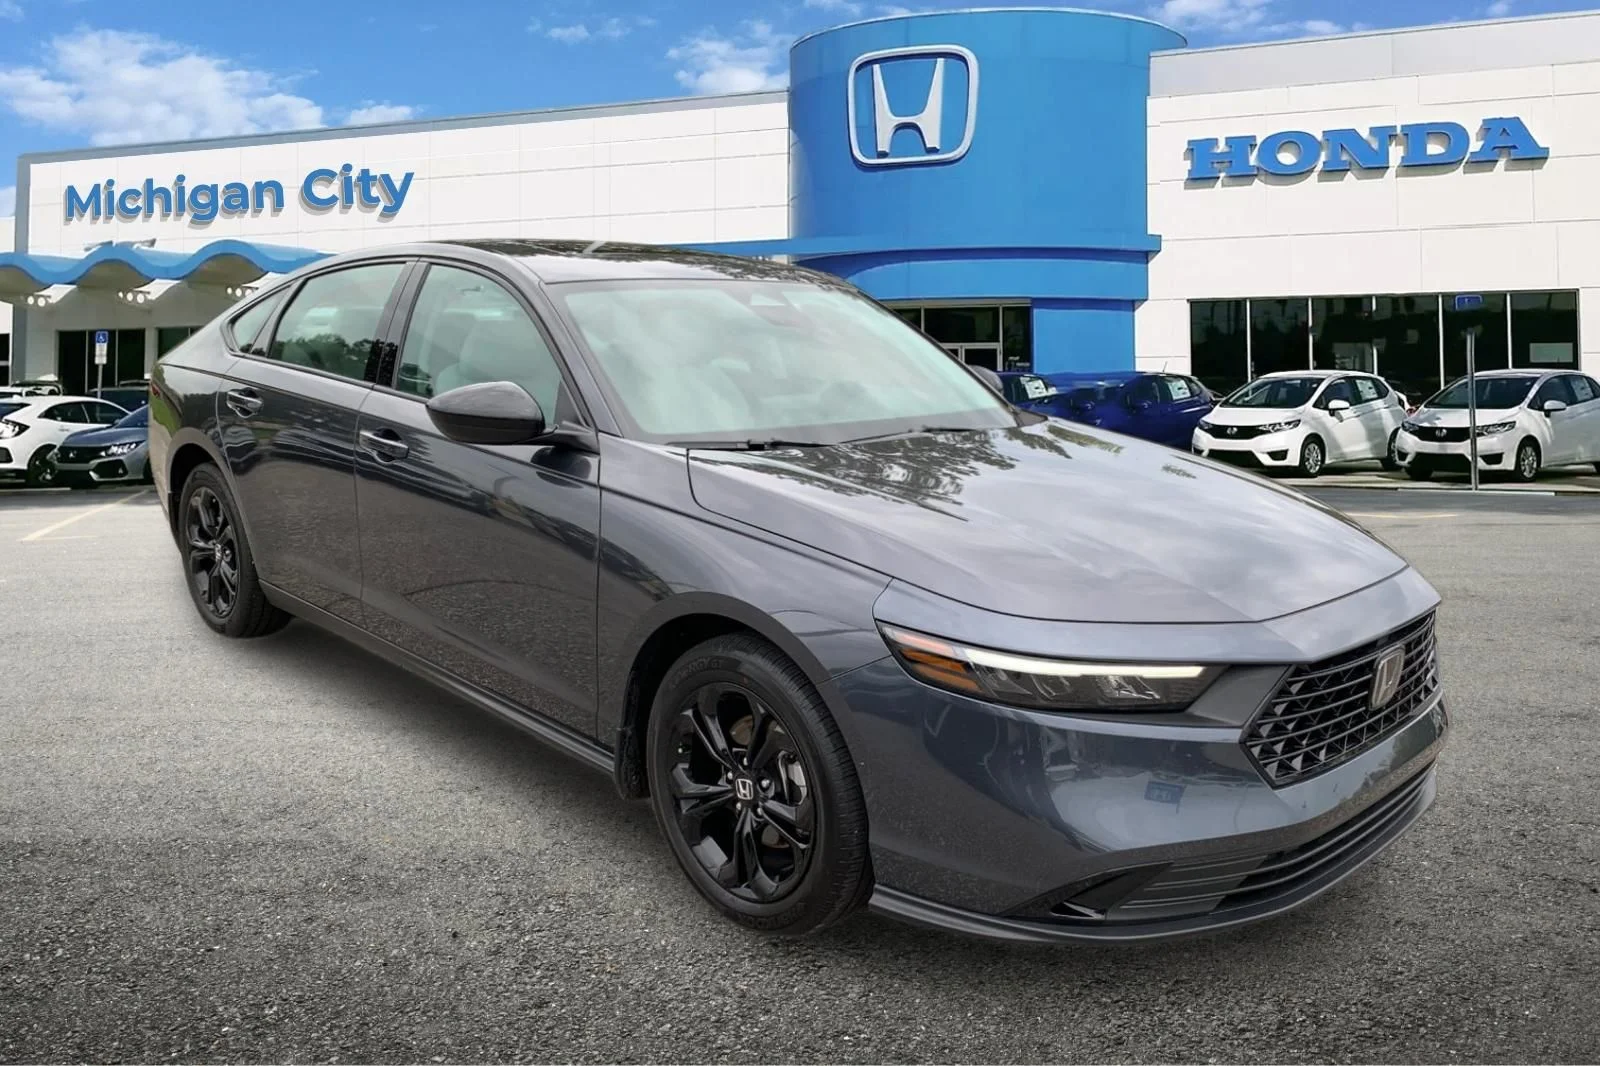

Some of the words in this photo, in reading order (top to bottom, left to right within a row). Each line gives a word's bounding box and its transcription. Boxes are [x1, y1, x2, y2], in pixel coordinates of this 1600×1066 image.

[1186, 116, 1550, 183] HONDA
[66, 174, 284, 222] Michigan
[302, 163, 415, 215] City
